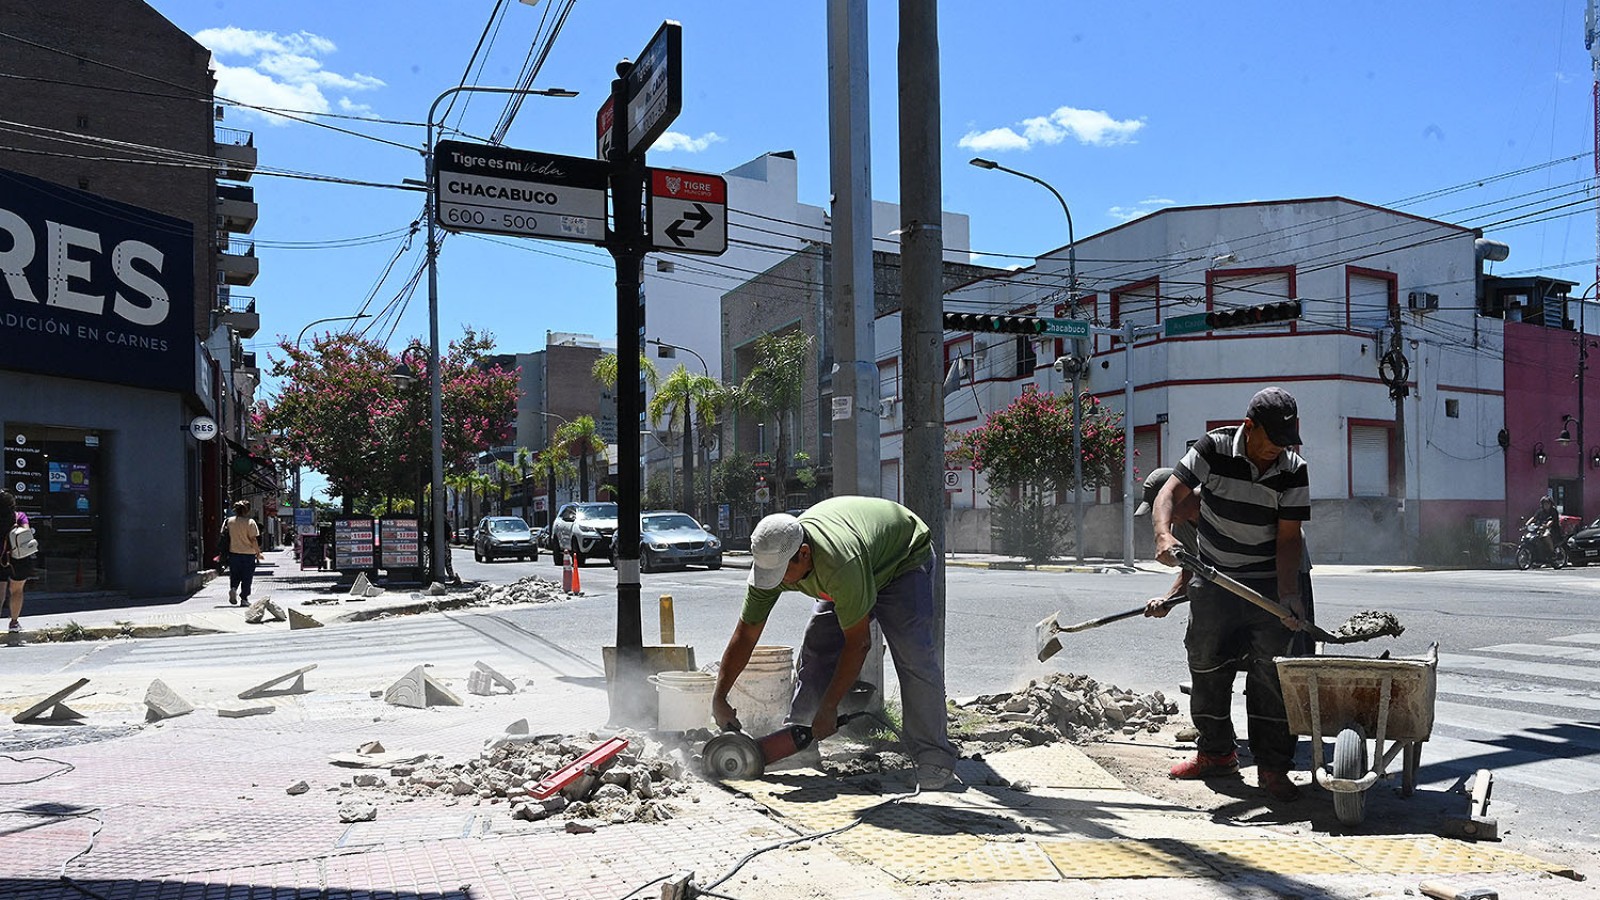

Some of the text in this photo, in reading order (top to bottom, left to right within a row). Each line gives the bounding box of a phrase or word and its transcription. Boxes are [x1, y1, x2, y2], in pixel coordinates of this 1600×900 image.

[451, 152, 566, 175] Tigre es mi vida
[448, 181, 558, 205] CHACABUCO
[683, 181, 712, 191] TIGRE
[448, 208, 484, 225] 600
[503, 214, 538, 230] 500
[78, 326, 99, 341] EN
[106, 331, 168, 352] CARNES
[194, 424, 213, 432] RES
